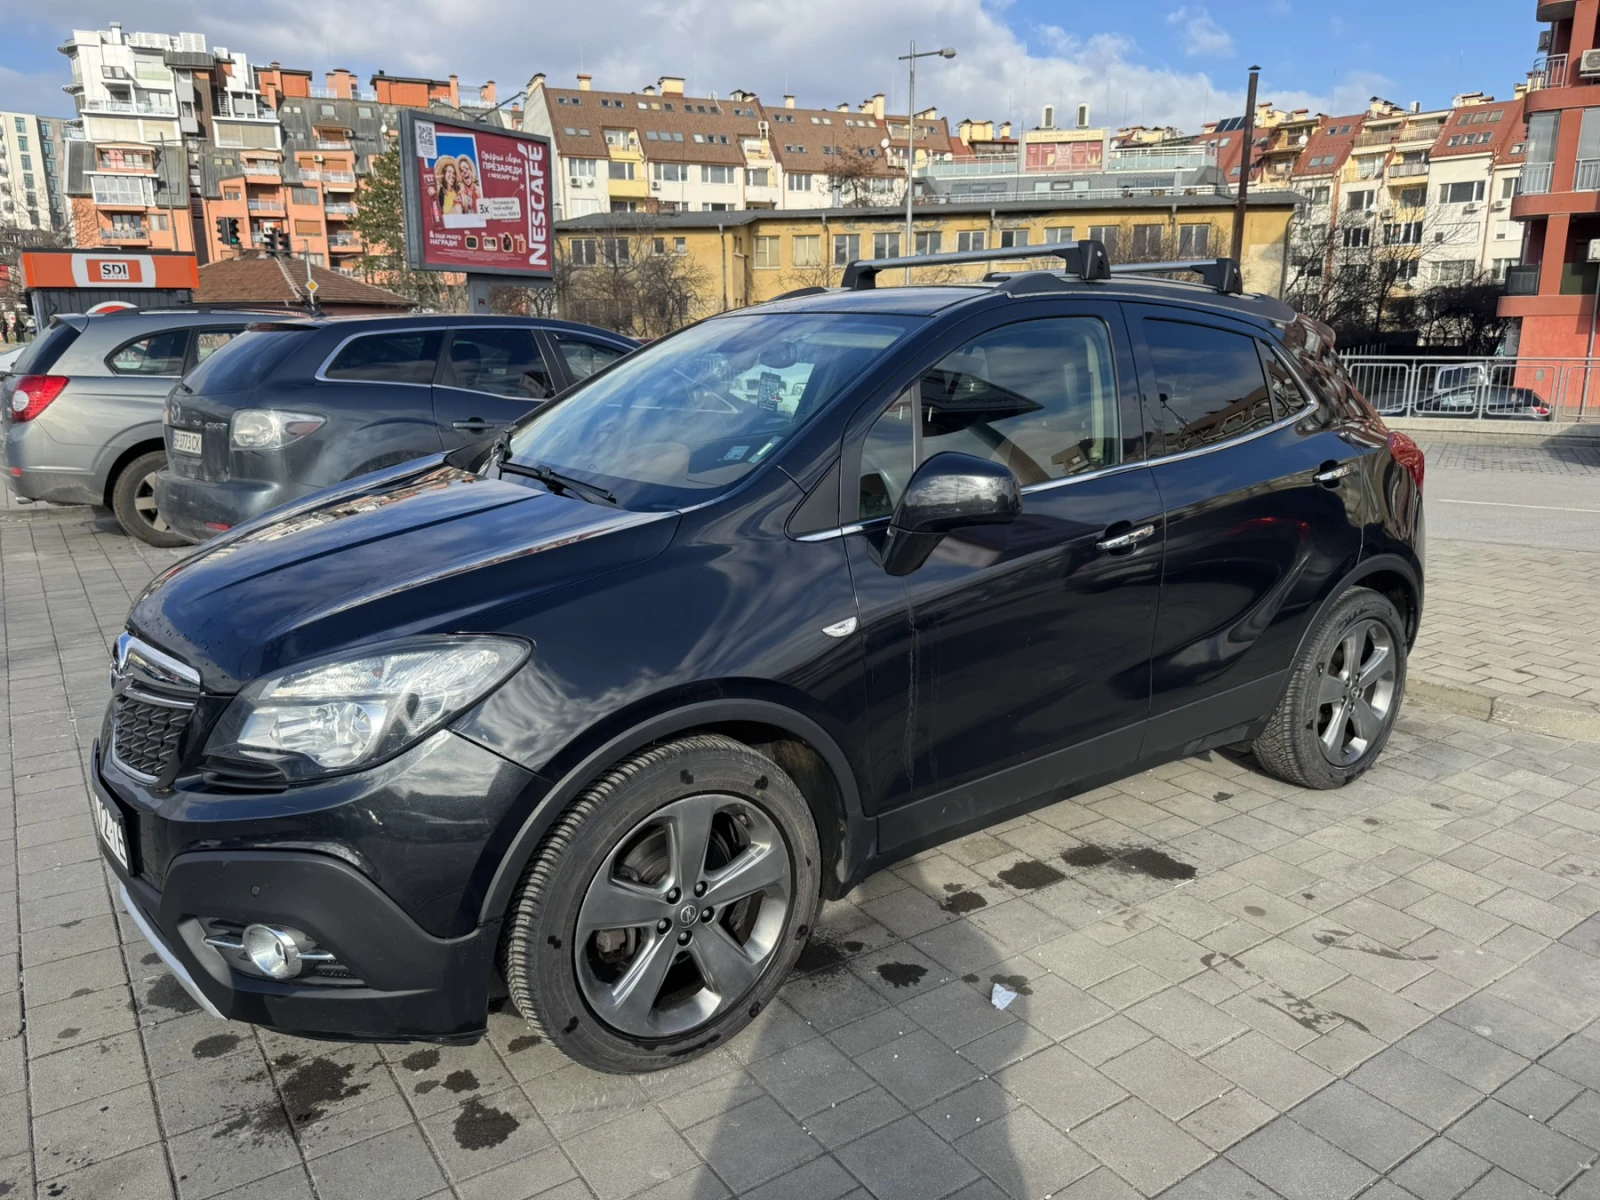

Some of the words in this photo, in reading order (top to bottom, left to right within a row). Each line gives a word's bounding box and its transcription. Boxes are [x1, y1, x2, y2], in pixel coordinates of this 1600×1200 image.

[483, 162, 523, 175] ПРЕЗАРЕДИ
[479, 205, 489, 213] 3x
[518, 143, 548, 266] NESCAFÉ
[102, 264, 127, 275] SDI
